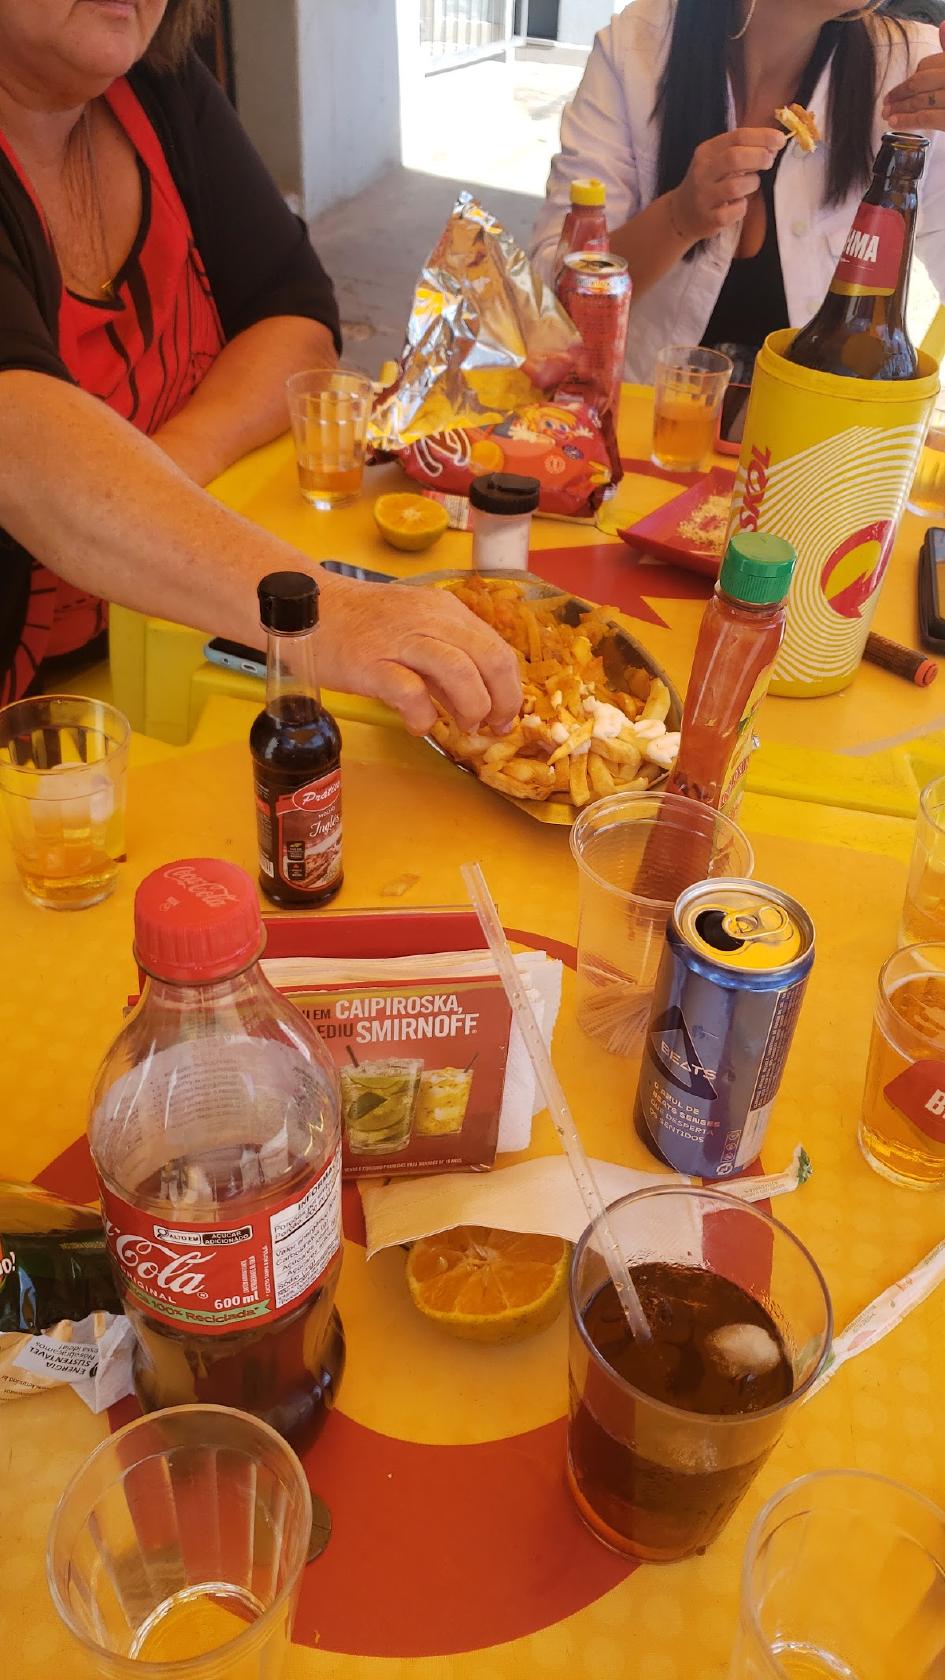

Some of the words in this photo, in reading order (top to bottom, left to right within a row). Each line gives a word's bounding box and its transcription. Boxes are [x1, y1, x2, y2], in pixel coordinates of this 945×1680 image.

[313, 1009, 331, 1021] EM
[335, 995, 463, 1020] CAIPIROSKA,
[356, 1013, 480, 1044] SMIRNOFF
[661, 1039, 717, 1081] BEATS
[686, 1105, 700, 1115] DE
[925, 1088, 945, 1118] B
[205, 1234, 248, 1245] ADICIONADO
[214, 1296, 240, 1310] 600
[242, 1290, 259, 1304] ml
[46, 1361, 86, 1375] ENERGIA
